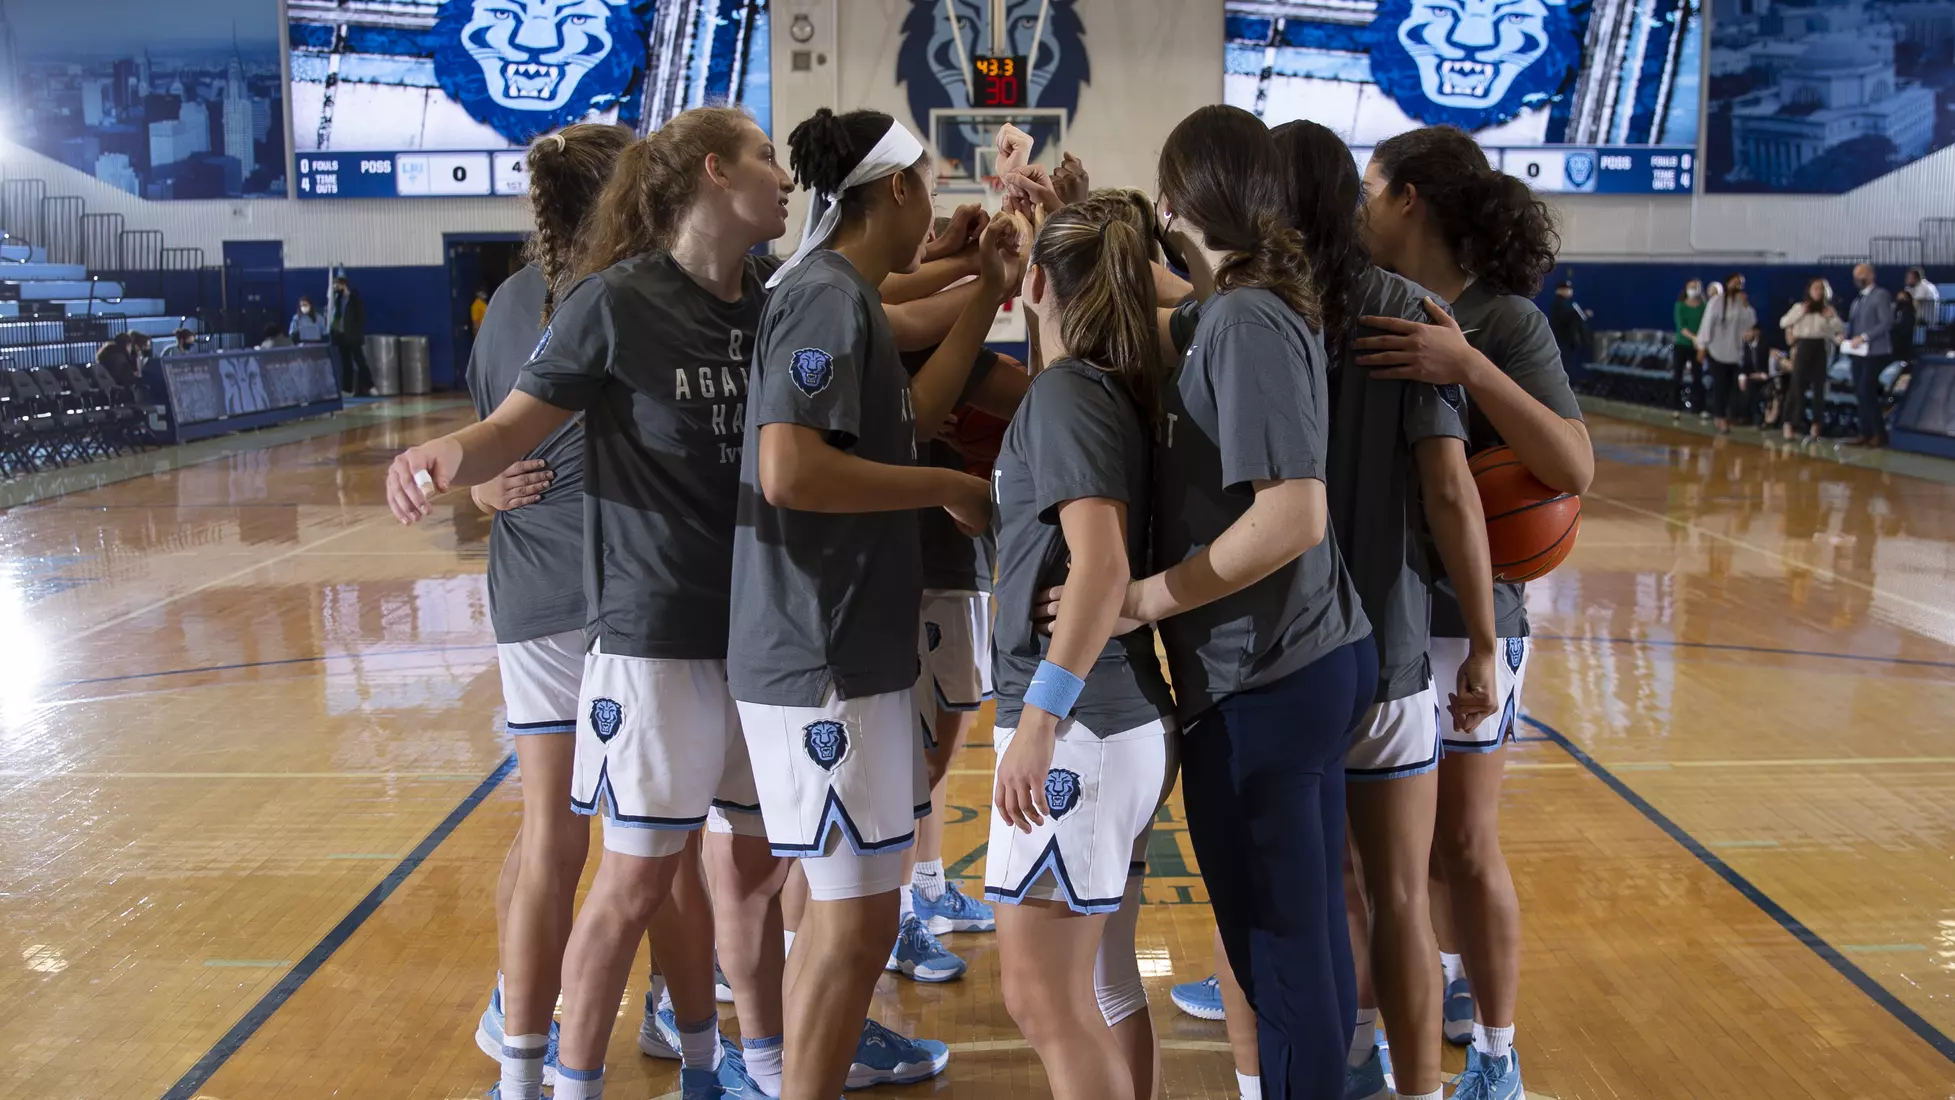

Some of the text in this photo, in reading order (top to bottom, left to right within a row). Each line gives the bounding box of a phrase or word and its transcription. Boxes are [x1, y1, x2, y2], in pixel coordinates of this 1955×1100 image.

[976, 58, 1014, 76] 43.3
[985, 76, 1017, 105] 30
[312, 160, 339, 171] FOULS
[360, 160, 392, 174] POSS
[1527, 163, 1540, 178] 0
[452, 166, 467, 182] 0
[301, 174, 338, 192] 4 TIME
[315, 184, 338, 194] OUTS
